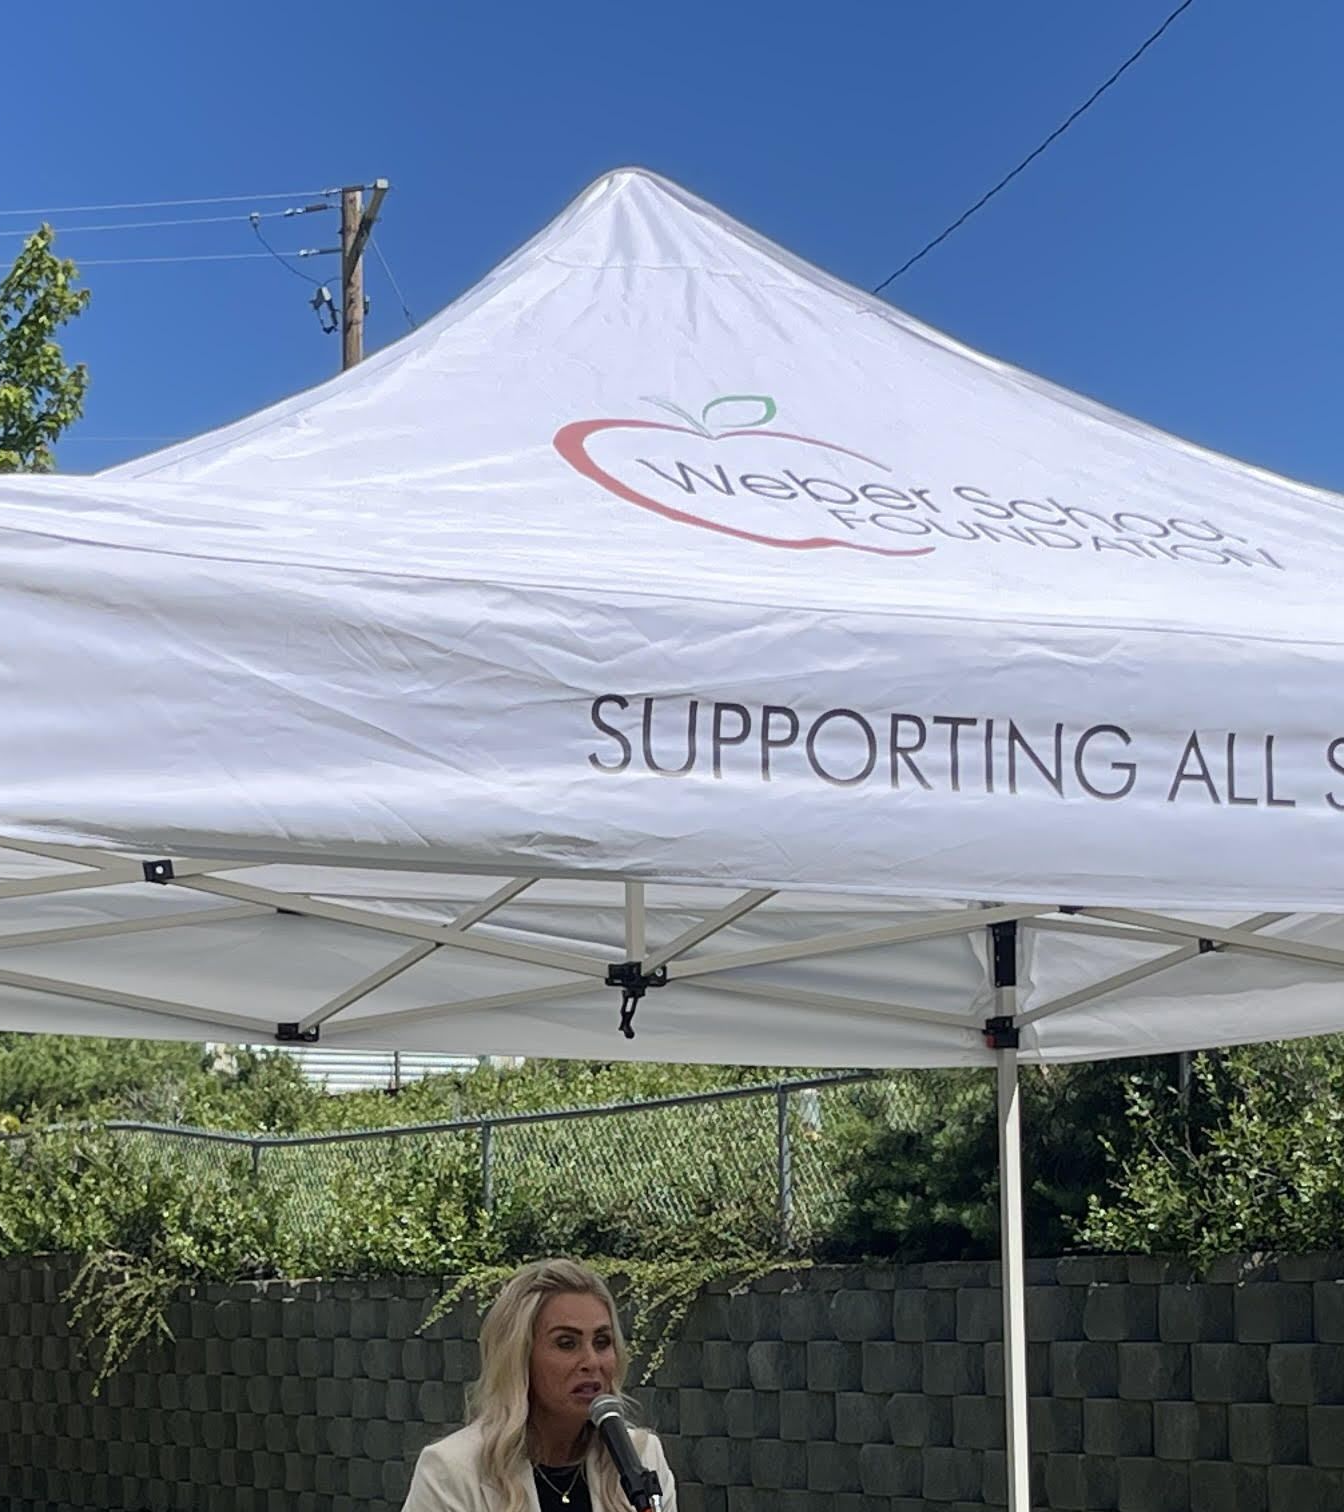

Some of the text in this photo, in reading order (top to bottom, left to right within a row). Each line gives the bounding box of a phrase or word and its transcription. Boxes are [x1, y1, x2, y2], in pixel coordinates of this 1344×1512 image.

[635, 458, 1248, 545] Weber School
[827, 508, 1286, 571] FOUNDATION
[588, 692, 1135, 801] SUPPORTING
[1166, 729, 1297, 808] ALL
